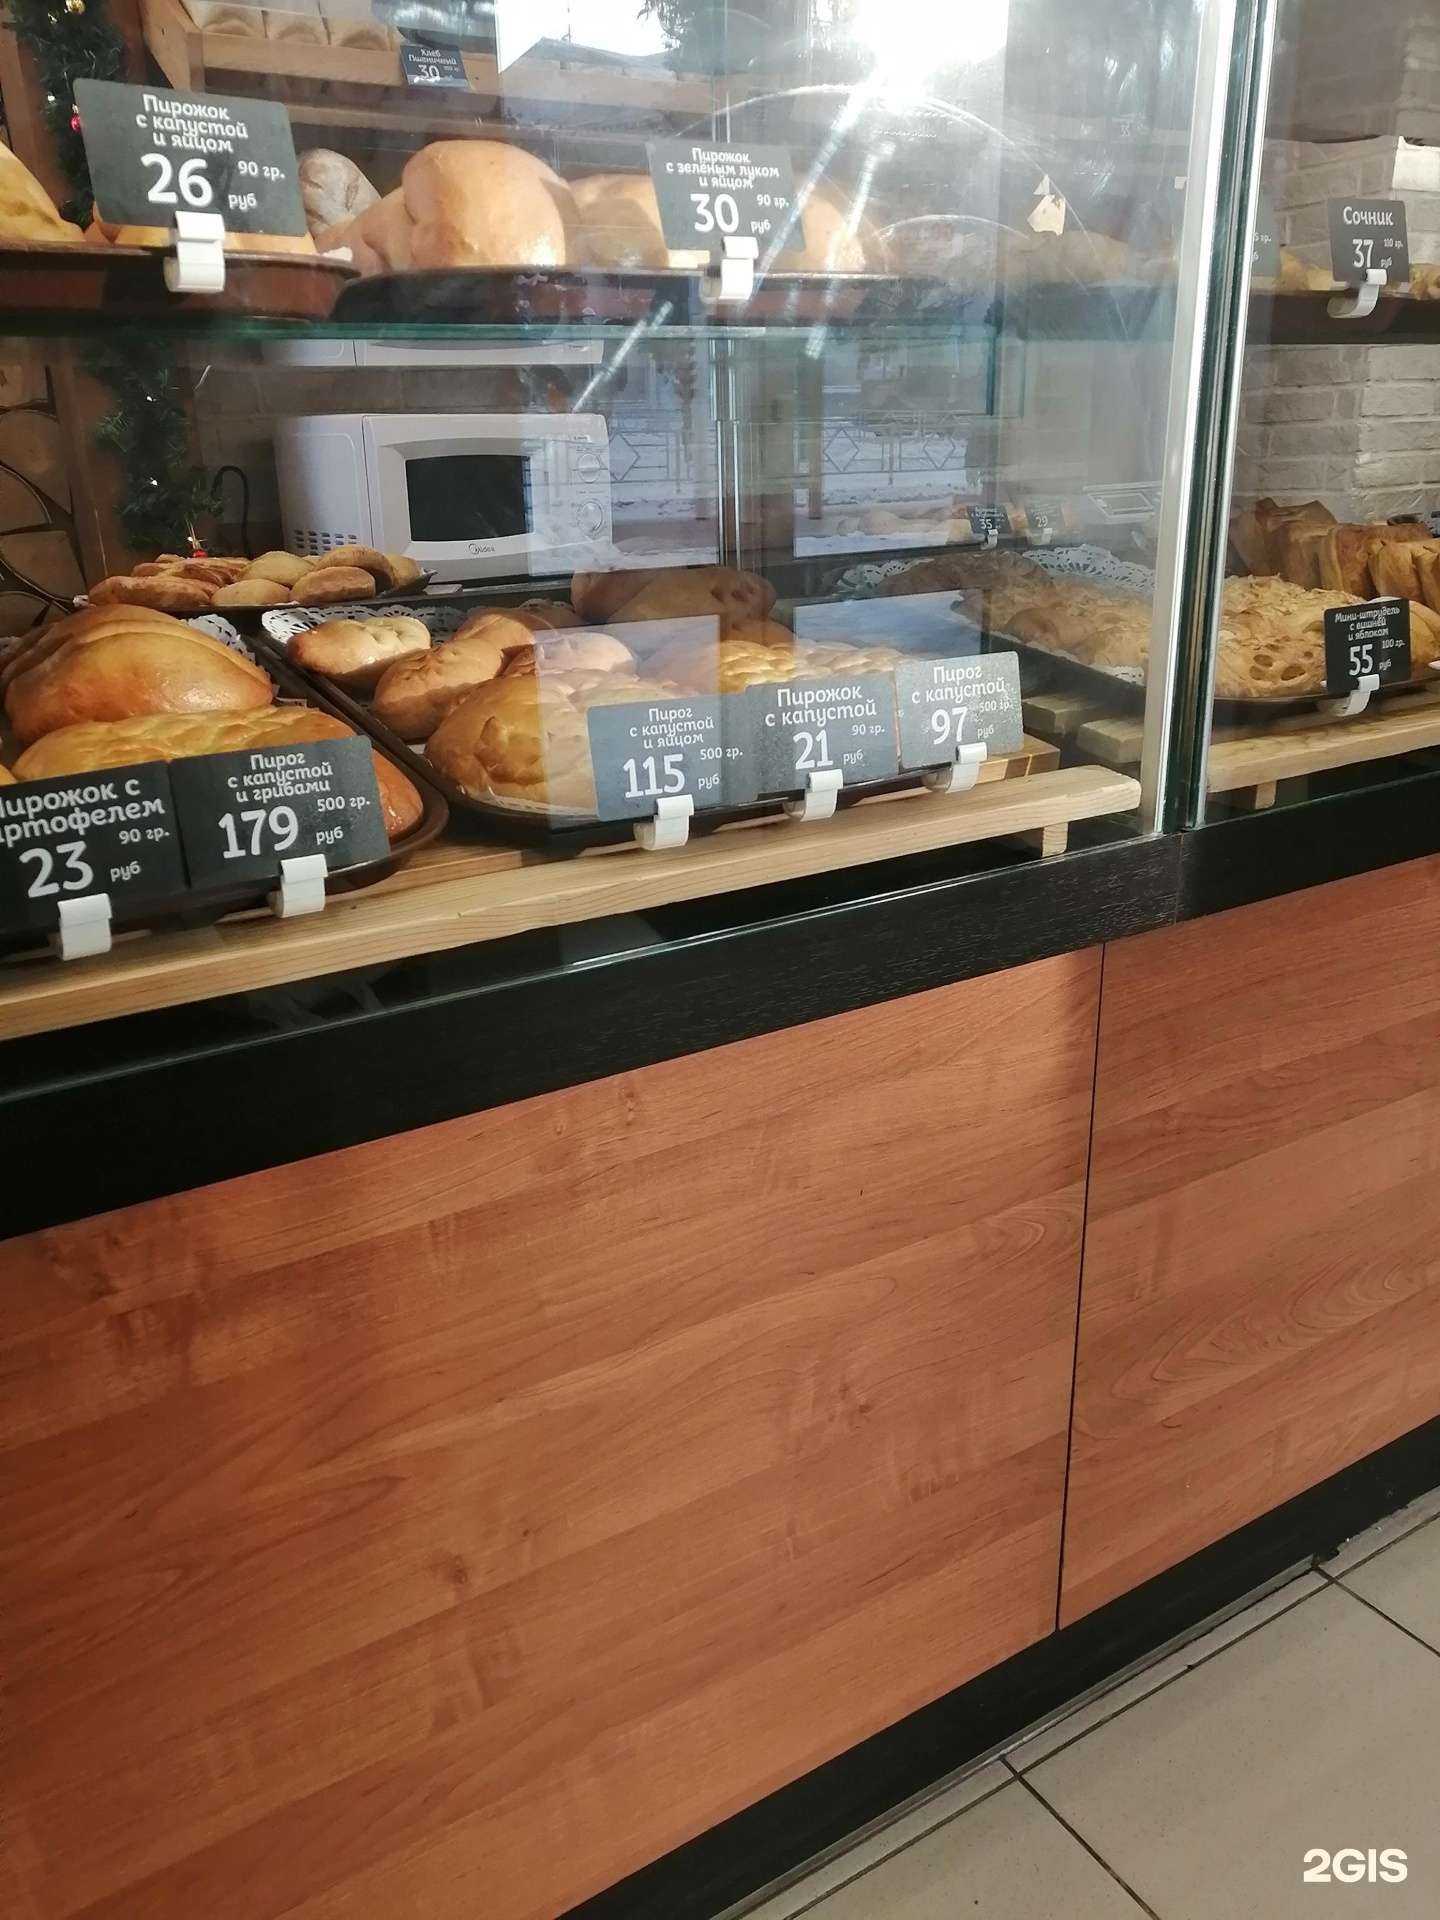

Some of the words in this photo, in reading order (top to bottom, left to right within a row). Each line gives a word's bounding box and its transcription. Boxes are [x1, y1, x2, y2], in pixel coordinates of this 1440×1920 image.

[142, 94, 230, 120] Пирожок
[135, 114, 148, 127] с
[152, 115, 249, 139] капустой
[152, 132, 166, 146] и
[171, 133, 234, 153] яйцом
[692, 147, 751, 164] Пирожок
[140, 153, 213, 207] 26
[238, 160, 258, 176] 90
[263, 165, 286, 181] гр.
[666, 162, 674, 173] с
[677, 162, 736, 176] зелёным
[740, 165, 780, 180] луком
[699, 177, 708, 187] и
[711, 176, 753, 190] яйцом
[228, 193, 257, 211] руб
[756, 194, 771, 206] 90
[773, 196, 789, 209] гр.
[690, 193, 739, 233] 30
[1343, 206, 1394, 226] Сочник
[751, 219, 771, 234] руб
[1352, 239, 1374, 268] 37
[1335, 606, 1400, 623] Мини-штрудель
[1356, 617, 1386, 630] вишней
[1348, 633, 1354, 641] и
[1355, 628, 1389, 640] яблоком
[1382, 638, 1394, 649] 100
[1349, 644, 1373, 676] 55
[1379, 658, 1392, 671] руб
[933, 665, 983, 686] Пирог
[777, 686, 863, 709] Пирожок
[911, 691, 920, 704] с
[926, 676, 1006, 703] капустой
[649, 707, 693, 722] Пирог
[765, 713, 775, 727] с
[782, 698, 877, 727] капустой
[980, 700, 997, 713] 500
[629, 727, 638, 737] с
[642, 716, 715, 737] капустой
[851, 723, 866, 735] 90
[869, 724, 885, 735] гр.
[931, 706, 968, 745] 97
[977, 724, 994, 740] руб
[643, 739, 653, 749] и
[657, 733, 704, 748] яйцом
[793, 729, 834, 770] 21
[250, 752, 306, 771] Пирог
[700, 747, 722, 760] 500
[726, 747, 743, 760] гр.
[843, 748, 863, 765] руб
[227, 776, 238, 788] с
[243, 762, 334, 787] капустой
[623, 753, 686, 799] 115
[698, 773, 720, 790] руб
[124, 779, 141, 796] с
[236, 791, 249, 802] и
[254, 780, 331, 804] грибами
[317, 796, 345, 812] 500
[350, 795, 371, 809] гр.
[0, 798, 165, 848] ртофелем
[218, 805, 299, 859] 179
[119, 828, 141, 845] 90
[145, 827, 170, 842] гр.
[316, 825, 344, 845] руб
[19, 840, 94, 898] 23
[110, 860, 141, 882] руб
